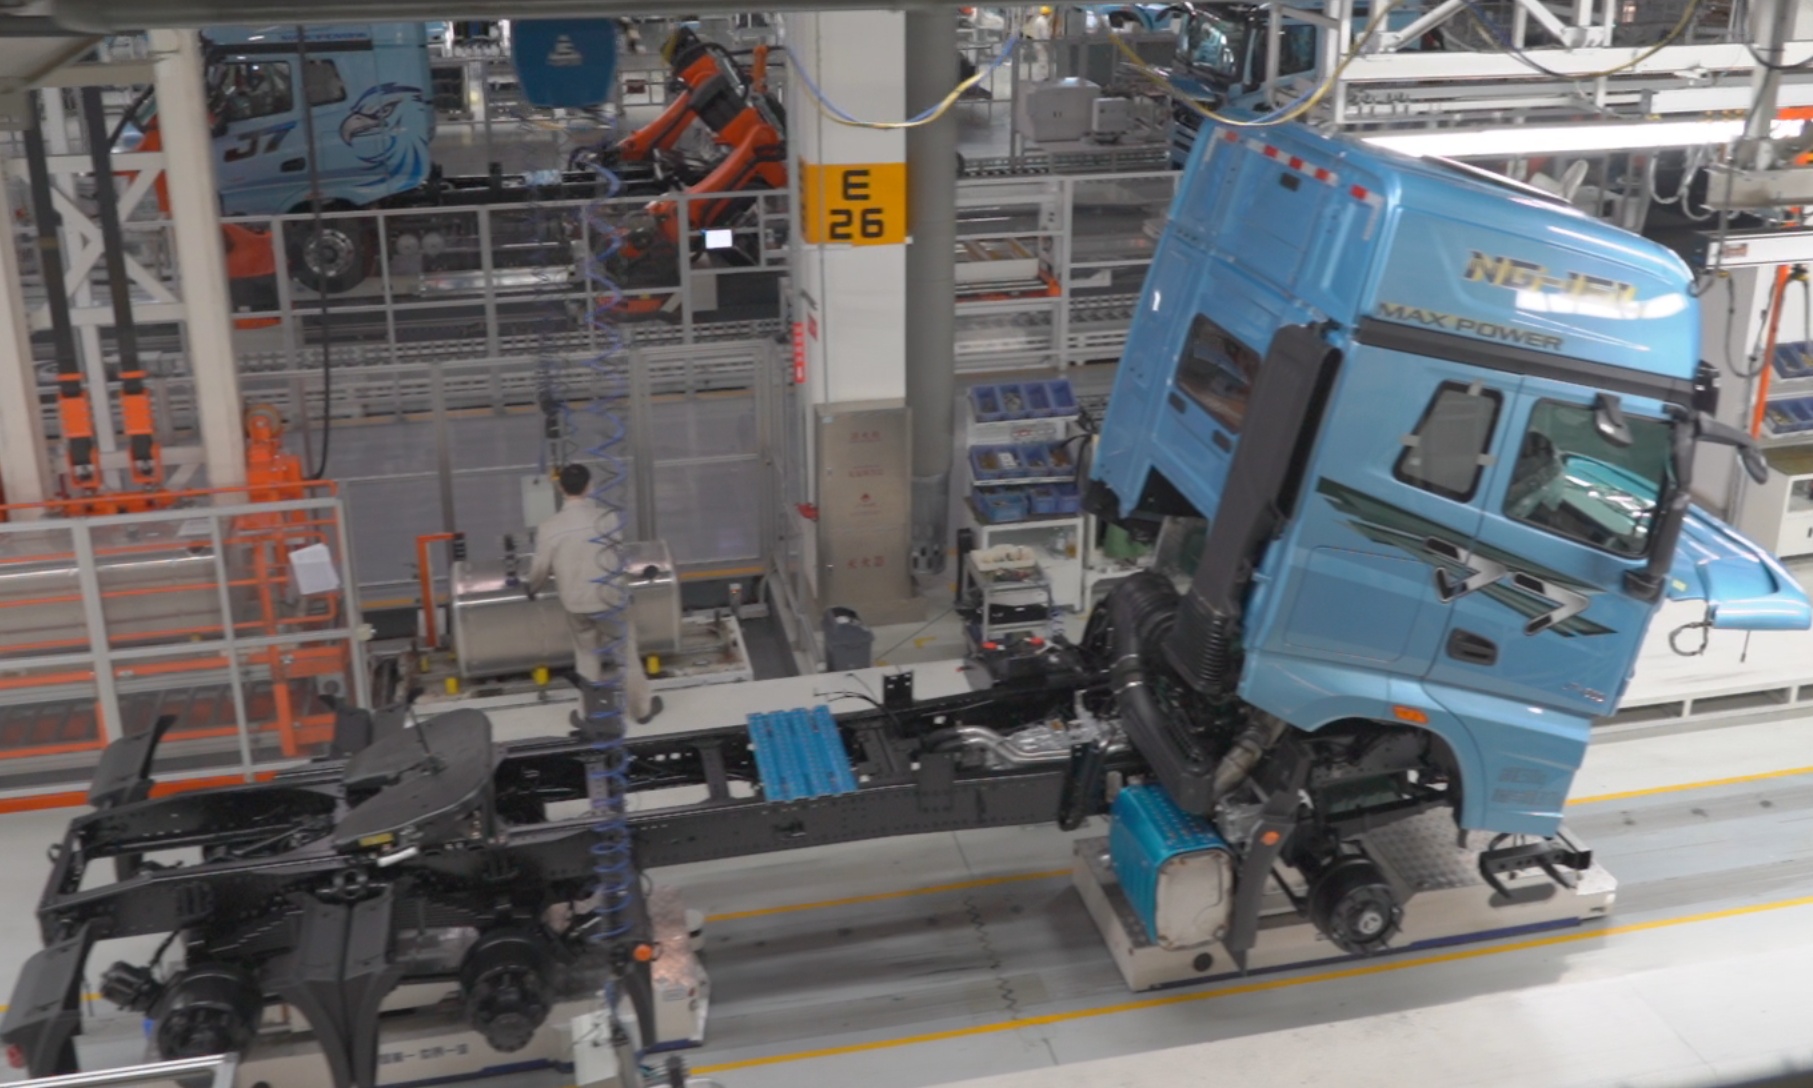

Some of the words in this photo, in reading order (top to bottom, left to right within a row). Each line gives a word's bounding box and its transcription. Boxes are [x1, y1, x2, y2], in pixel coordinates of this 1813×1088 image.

[843, 169, 870, 200] E
[829, 208, 884, 240] 26
[1380, 303, 1449, 328] MAX
[1455, 317, 1565, 350] POWER
